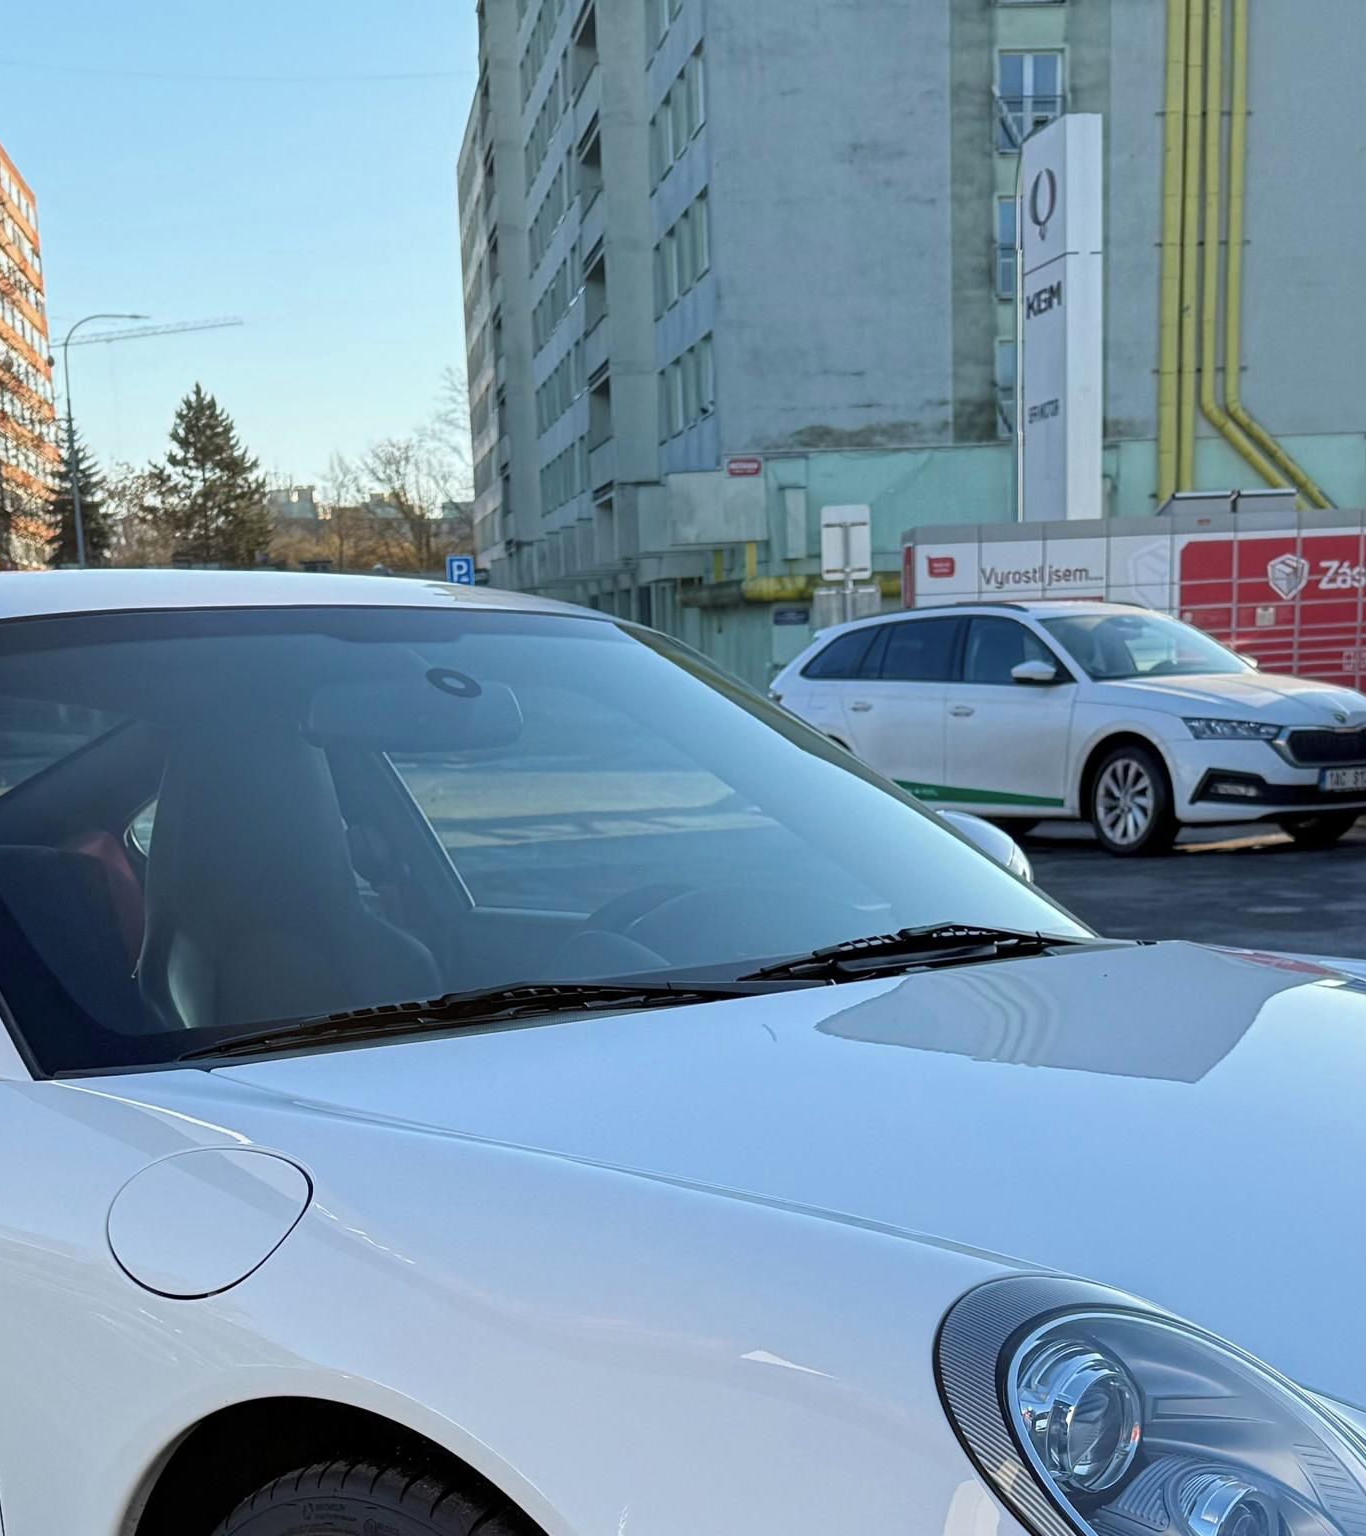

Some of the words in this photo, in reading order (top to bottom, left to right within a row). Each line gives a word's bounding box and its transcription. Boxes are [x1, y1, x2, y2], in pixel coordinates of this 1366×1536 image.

[1026, 281, 1062, 320] KGM
[452, 561, 468, 583] P
[980, 566, 1044, 589] Vyrostl
